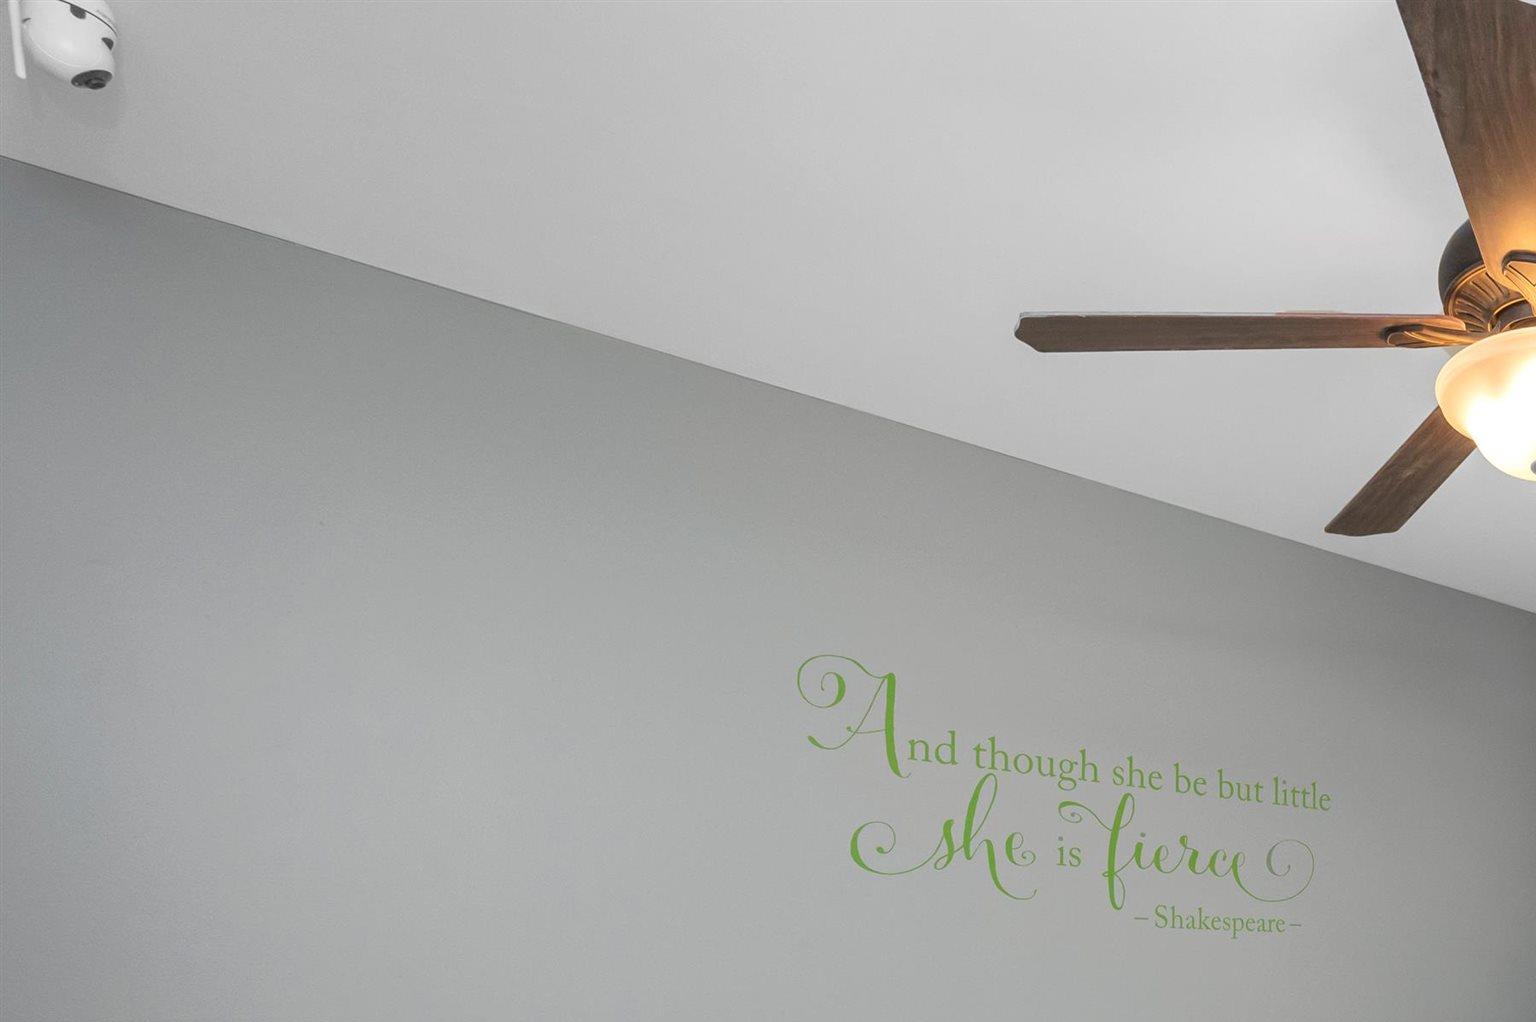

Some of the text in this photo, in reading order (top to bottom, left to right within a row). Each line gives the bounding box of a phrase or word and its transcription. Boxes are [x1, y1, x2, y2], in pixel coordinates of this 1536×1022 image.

[797, 654, 1332, 811] And though she be but little
[850, 773, 1314, 911] she is fierce
